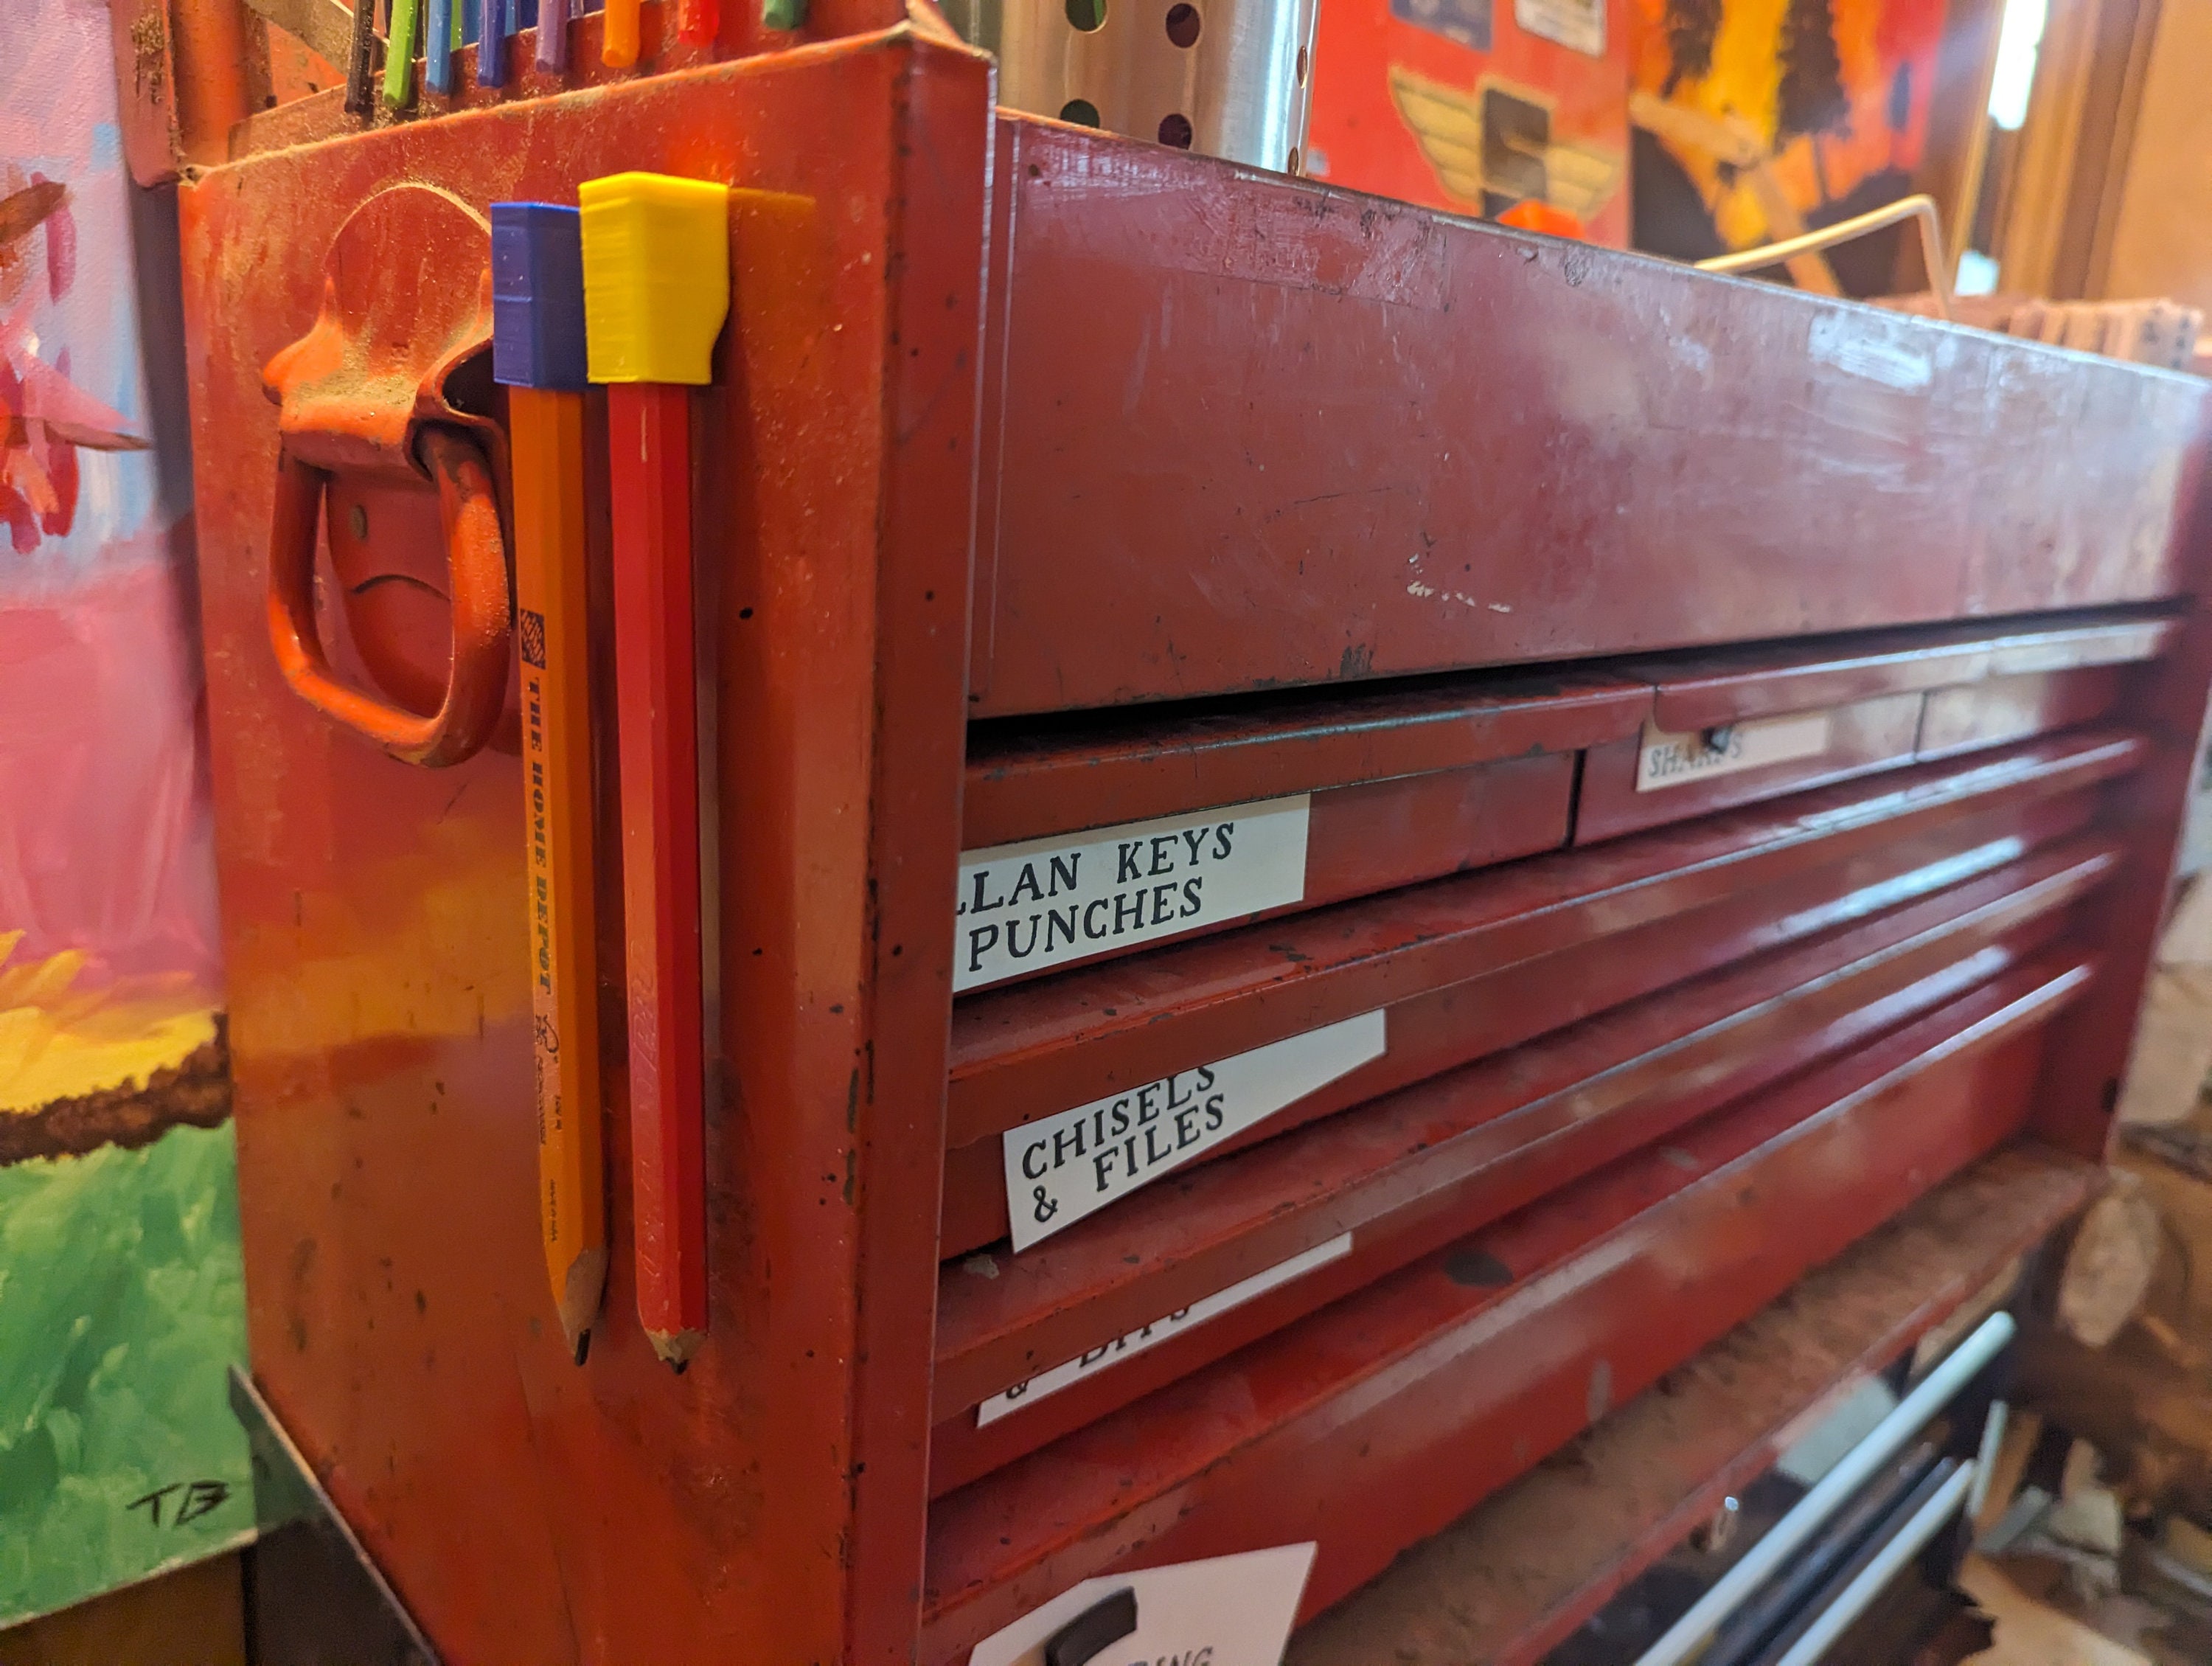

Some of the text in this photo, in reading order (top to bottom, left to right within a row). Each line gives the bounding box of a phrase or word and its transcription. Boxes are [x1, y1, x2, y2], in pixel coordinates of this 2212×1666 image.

[528, 676, 543, 752] THE
[532, 761, 547, 868] HOME
[1116, 822, 1235, 884] KEYS
[536, 875, 552, 995] DEPOT
[968, 876, 1203, 972] PUNCHES
[1021, 1066, 1216, 1180] CHISELS
[1032, 1093, 1225, 1224] & FILES
